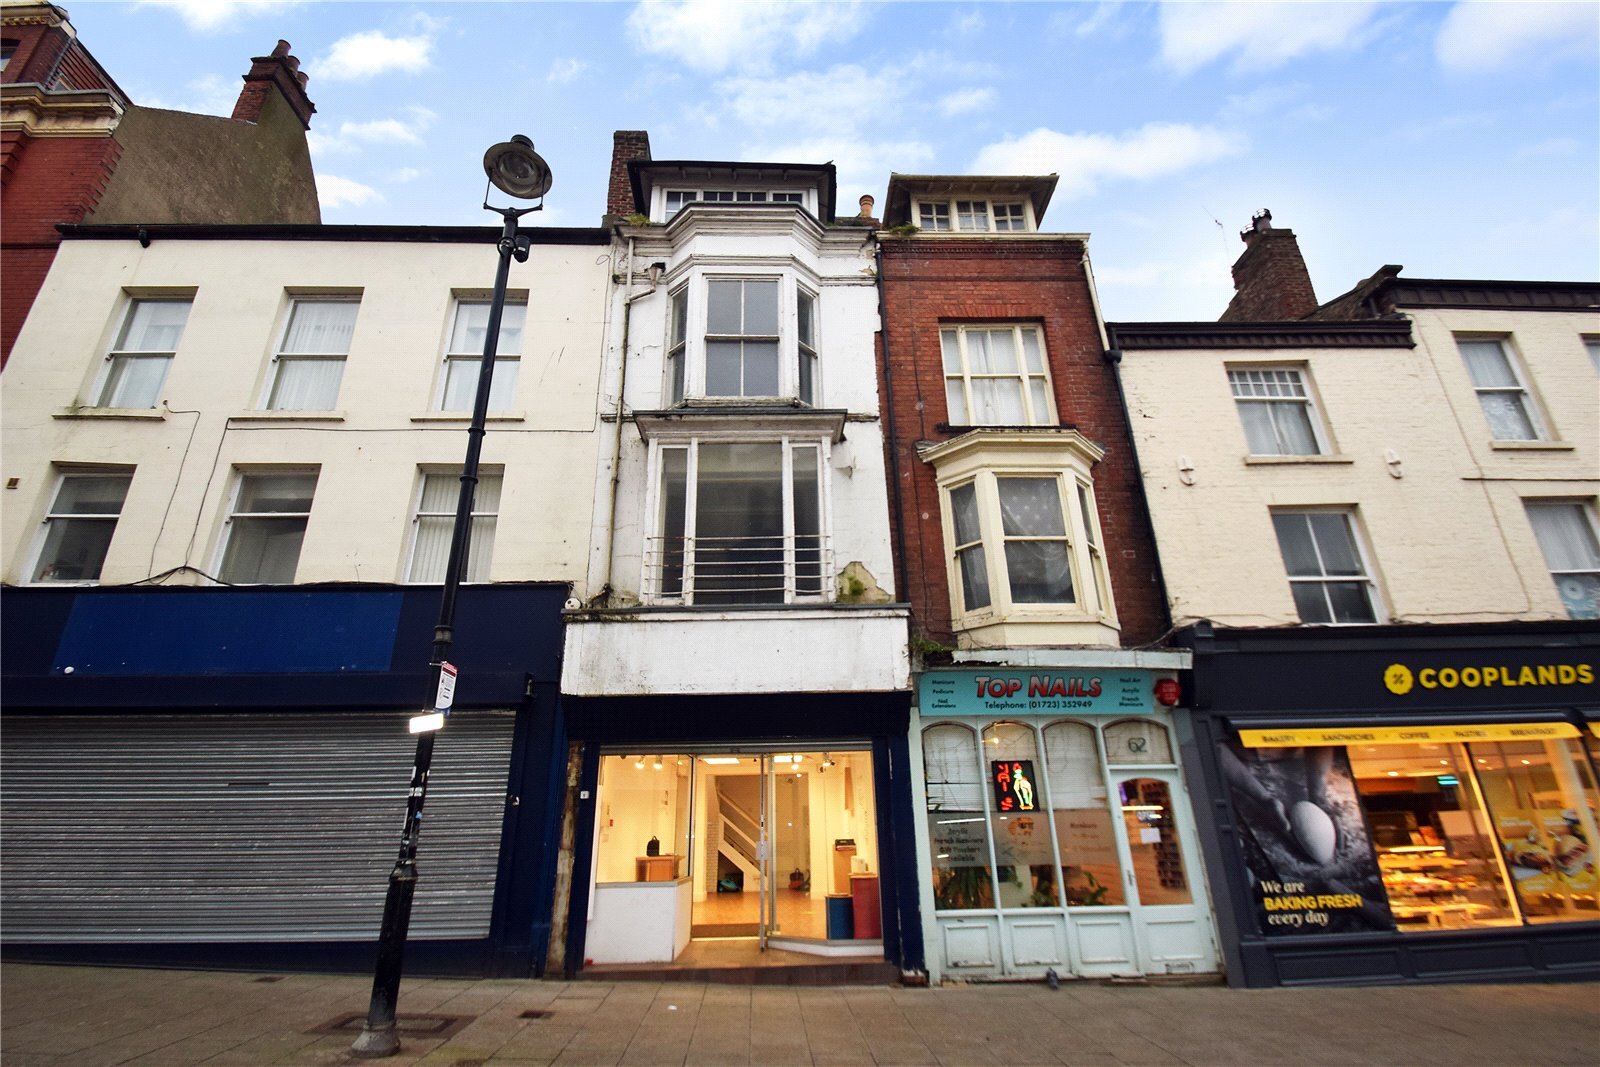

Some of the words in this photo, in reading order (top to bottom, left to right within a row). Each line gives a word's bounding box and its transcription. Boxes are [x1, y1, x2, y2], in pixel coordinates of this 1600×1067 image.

[1418, 664, 1596, 689] COOPLANDS
[975, 675, 1023, 698] TOP
[1028, 674, 1103, 698] NAILS
[985, 701, 1027, 711] Telephone:
[1028, 700, 1060, 709] (01723)
[1062, 700, 1093, 708] 352949
[1128, 737, 1147, 752] 62
[1261, 881, 1282, 893] We
[1283, 882, 1305, 893] are
[1263, 895, 1318, 911] BAKING
[1317, 894, 1363, 909] FRESH
[1268, 913, 1303, 927] every
[1305, 910, 1329, 926] day
